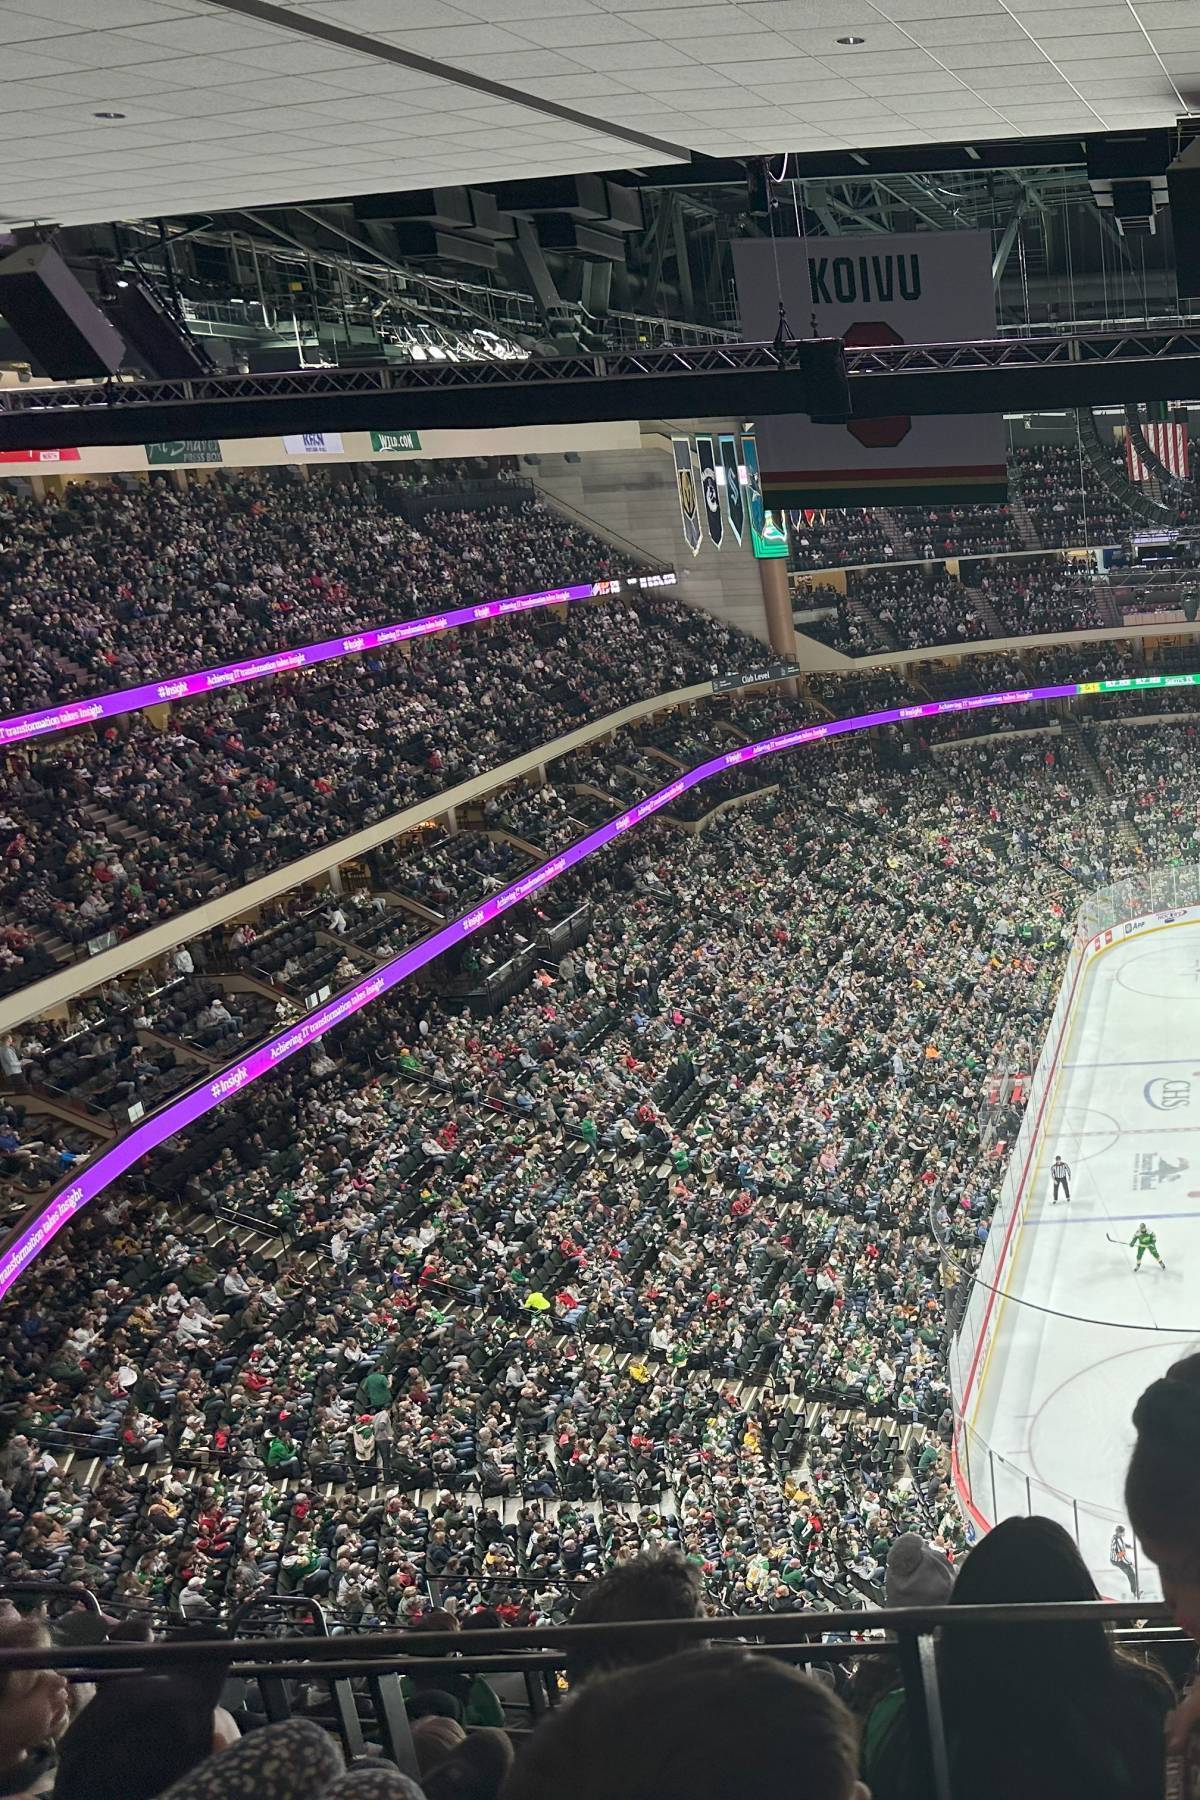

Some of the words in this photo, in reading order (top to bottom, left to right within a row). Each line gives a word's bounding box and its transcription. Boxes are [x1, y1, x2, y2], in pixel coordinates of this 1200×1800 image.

[808, 254, 921, 304] KOIVU
[207, 452, 222, 462] BOX
[742, 674, 754, 684] Club
[754, 671, 770, 681] Level
[6, 715, 60, 736] transformation
[61, 710, 79, 722] takes
[79, 703, 104, 717] Insight
[270, 1033, 304, 1059] Achieving
[302, 1025, 311, 1038] IT
[310, 1002, 351, 1033] transformation
[351, 989, 366, 1005] takes
[365, 977, 385, 998] Insight
[1161, 1080, 1191, 1108] CHS
[42, 1211, 60, 1233] takes
[58, 1187, 83, 1216] Insight
